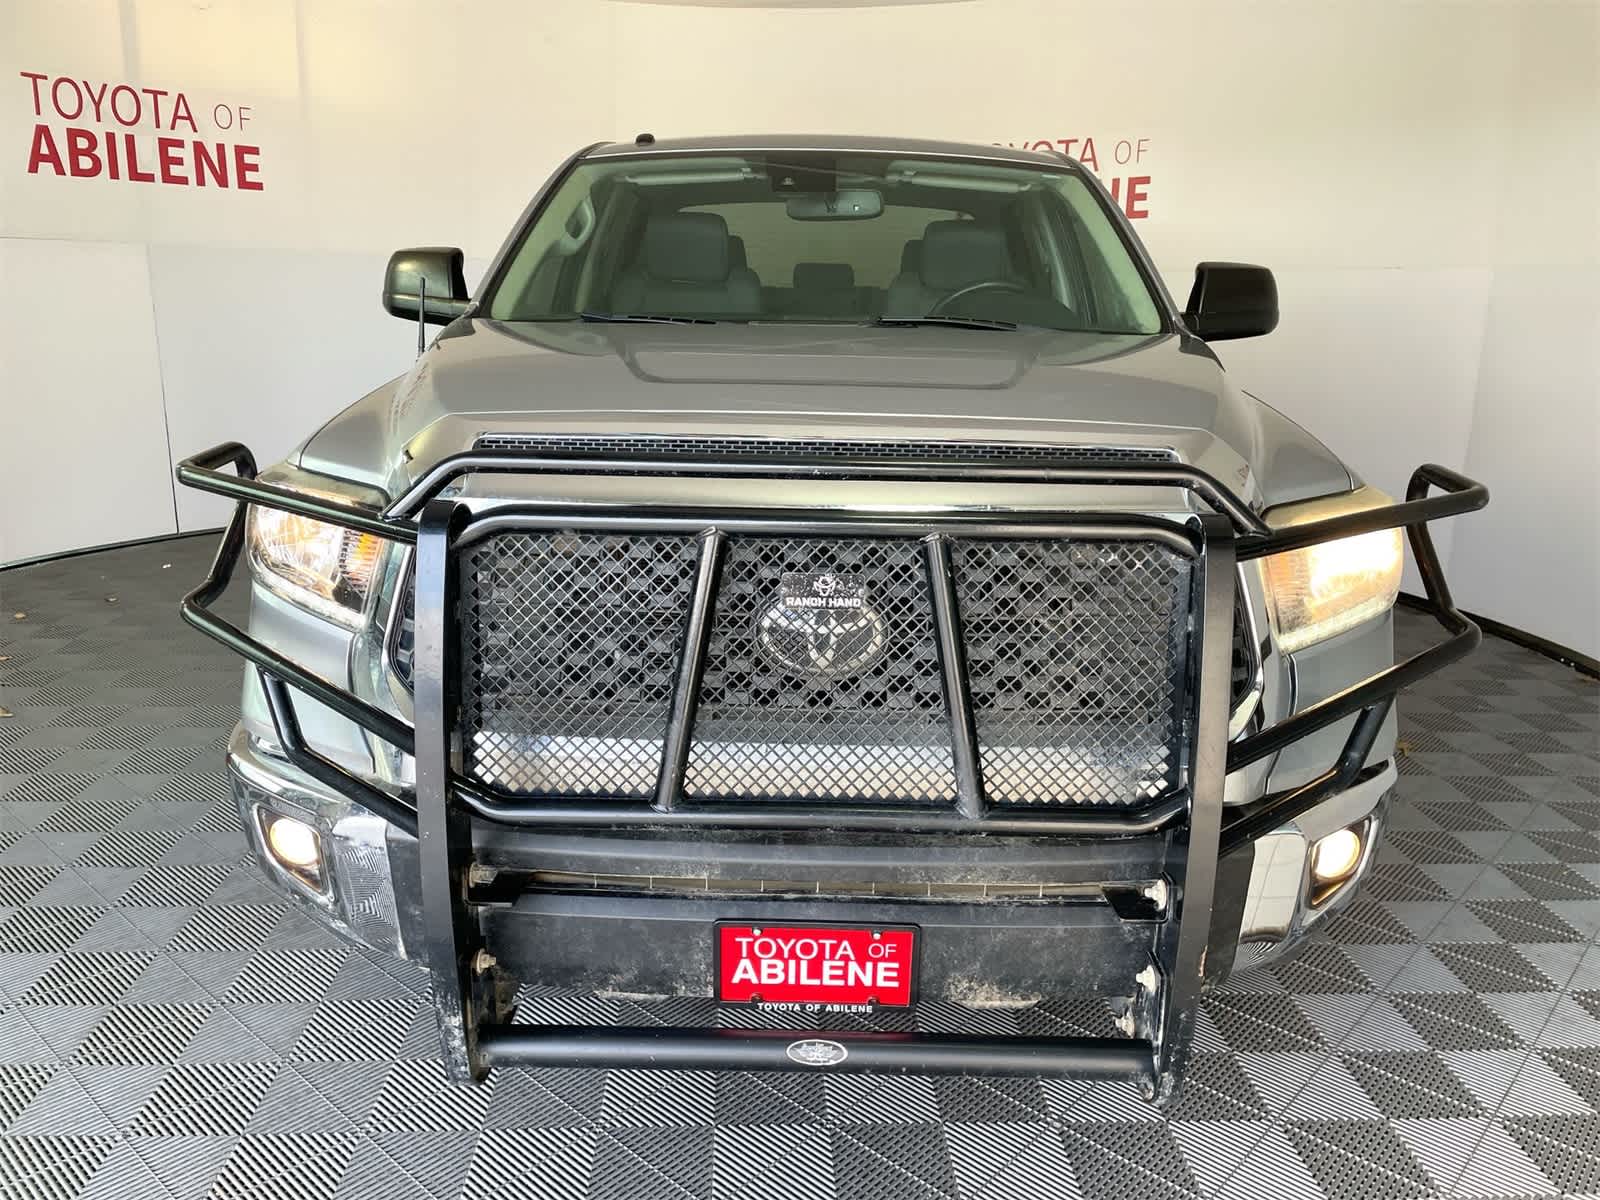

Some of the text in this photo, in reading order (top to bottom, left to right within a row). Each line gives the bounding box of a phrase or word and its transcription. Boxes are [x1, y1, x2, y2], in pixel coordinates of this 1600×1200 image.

[20, 71, 251, 133] TOYOTA OF
[28, 124, 264, 190] ABILENE
[1114, 138, 1150, 165] OF
[786, 597, 861, 607] RANCH HAND
[735, 937, 897, 960] TOYOTA OF
[731, 958, 899, 988] ABILENE
[757, 1003, 801, 1011] TOYOTA
[825, 1004, 873, 1013] ABILENE
